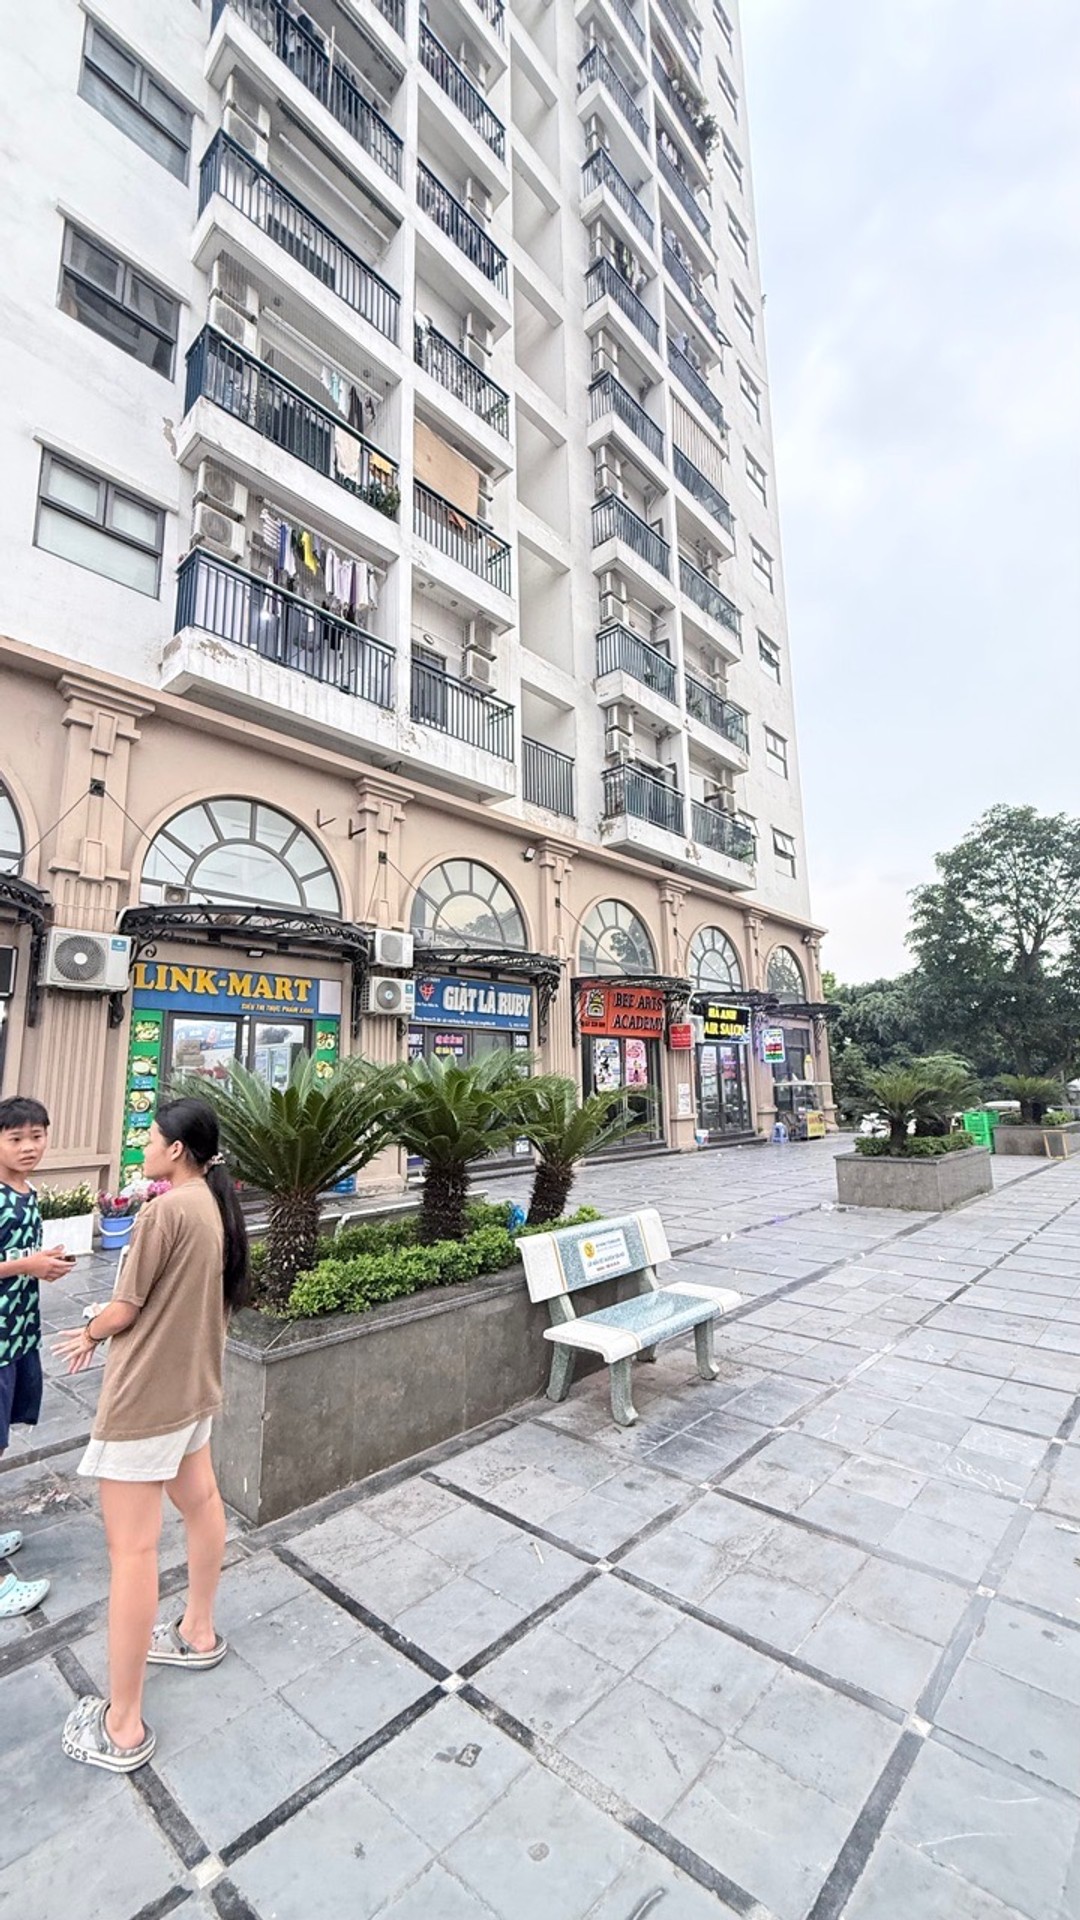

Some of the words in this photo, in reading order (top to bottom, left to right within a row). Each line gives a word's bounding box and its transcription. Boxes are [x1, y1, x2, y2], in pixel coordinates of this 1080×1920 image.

[133, 963, 312, 1002] LINK-MART
[442, 981, 477, 1016] GIẶT
[477, 985, 496, 1014] LÀ
[496, 992, 531, 1017] RUBY
[614, 991, 635, 1008] BEE
[636, 995, 663, 1011] ARTS
[613, 1014, 664, 1031] ACADEMY
[704, 1021, 719, 1035] AIR
[719, 1022, 746, 1037] SALON
